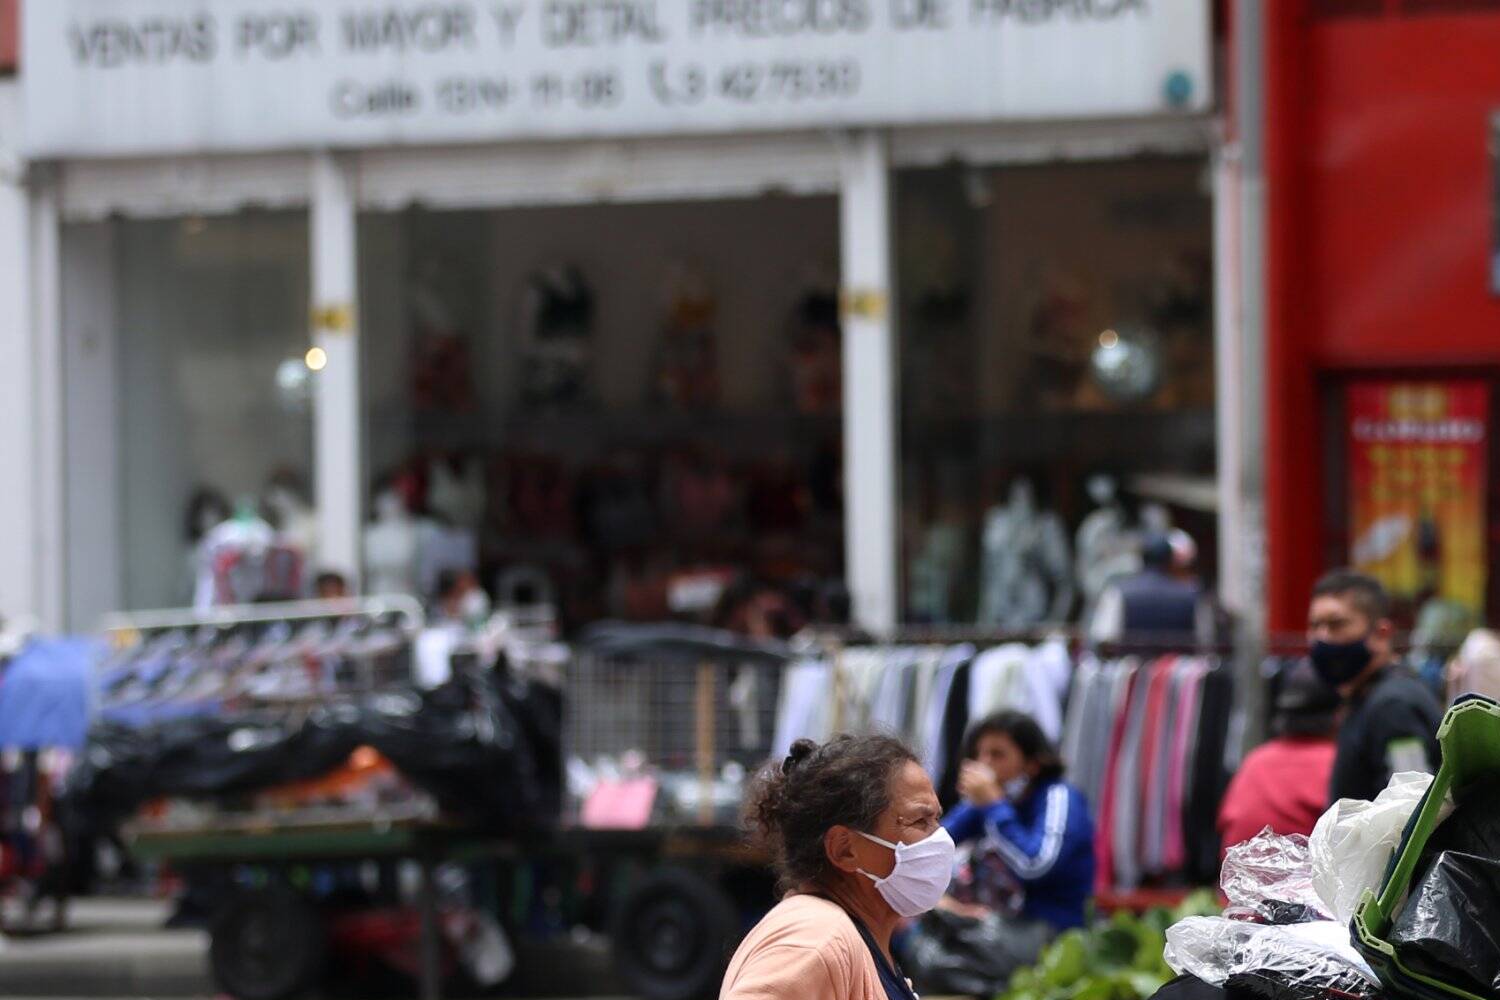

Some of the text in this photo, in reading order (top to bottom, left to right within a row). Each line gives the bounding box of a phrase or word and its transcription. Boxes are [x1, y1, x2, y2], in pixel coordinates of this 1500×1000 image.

[70, 15, 214, 66] VENTAS
[236, 11, 318, 58] POR
[340, 5, 474, 53] MAYOR
[494, 3, 520, 48] Y
